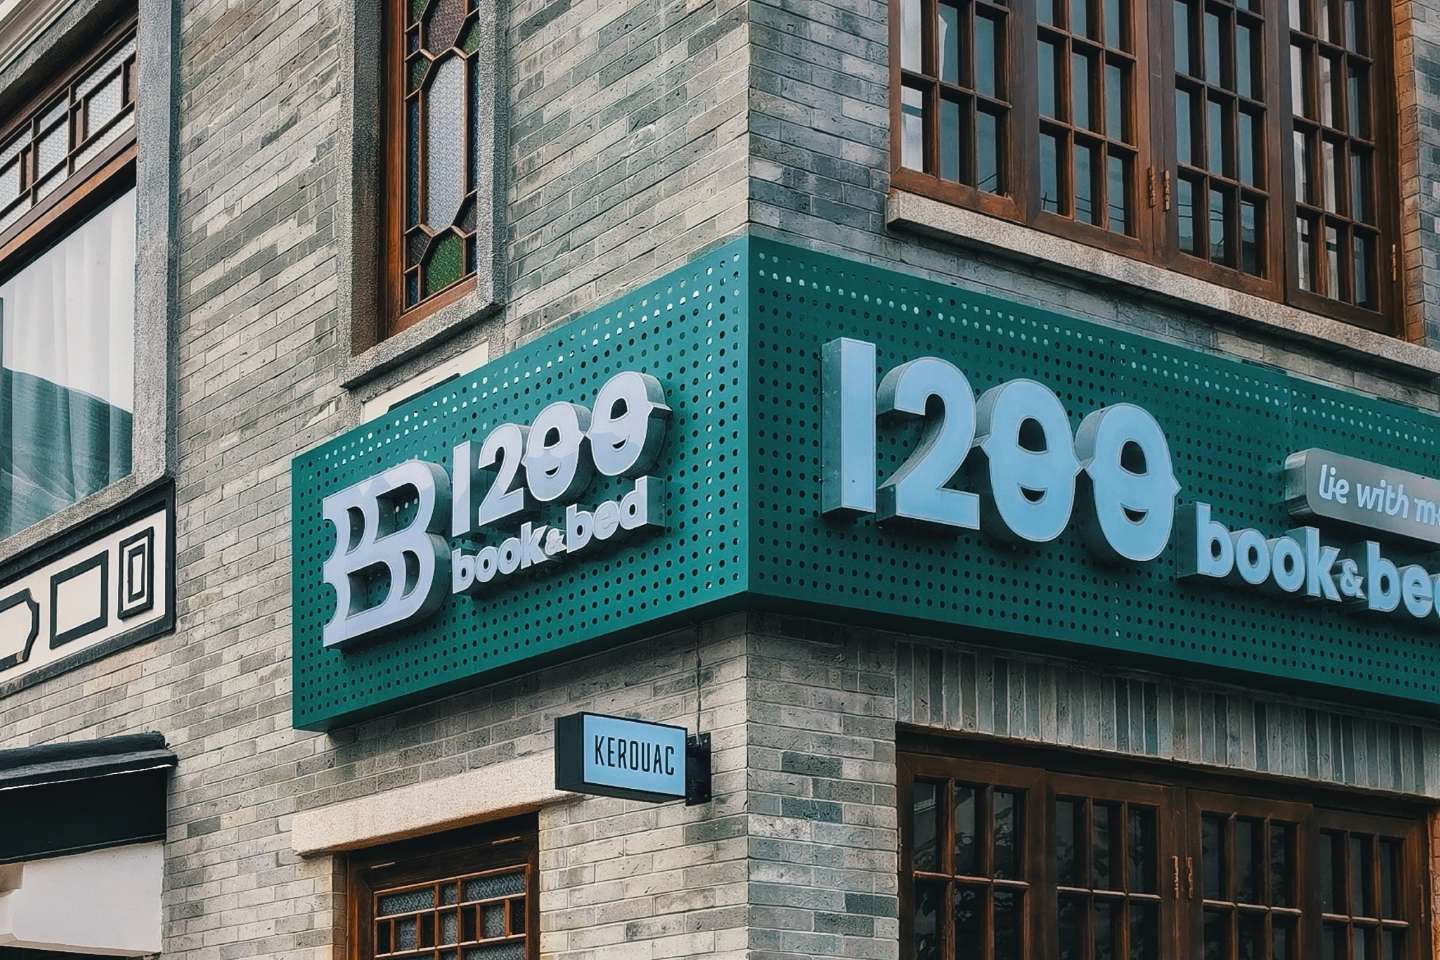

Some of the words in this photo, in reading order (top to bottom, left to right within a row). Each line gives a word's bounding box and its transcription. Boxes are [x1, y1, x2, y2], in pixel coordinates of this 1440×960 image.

[452, 371, 671, 537] 1200
[822, 337, 1181, 562] 1200
[1357, 479, 1409, 519] with
[1192, 501, 1440, 619] book&be
[594, 735, 675, 776] KEROUAC
